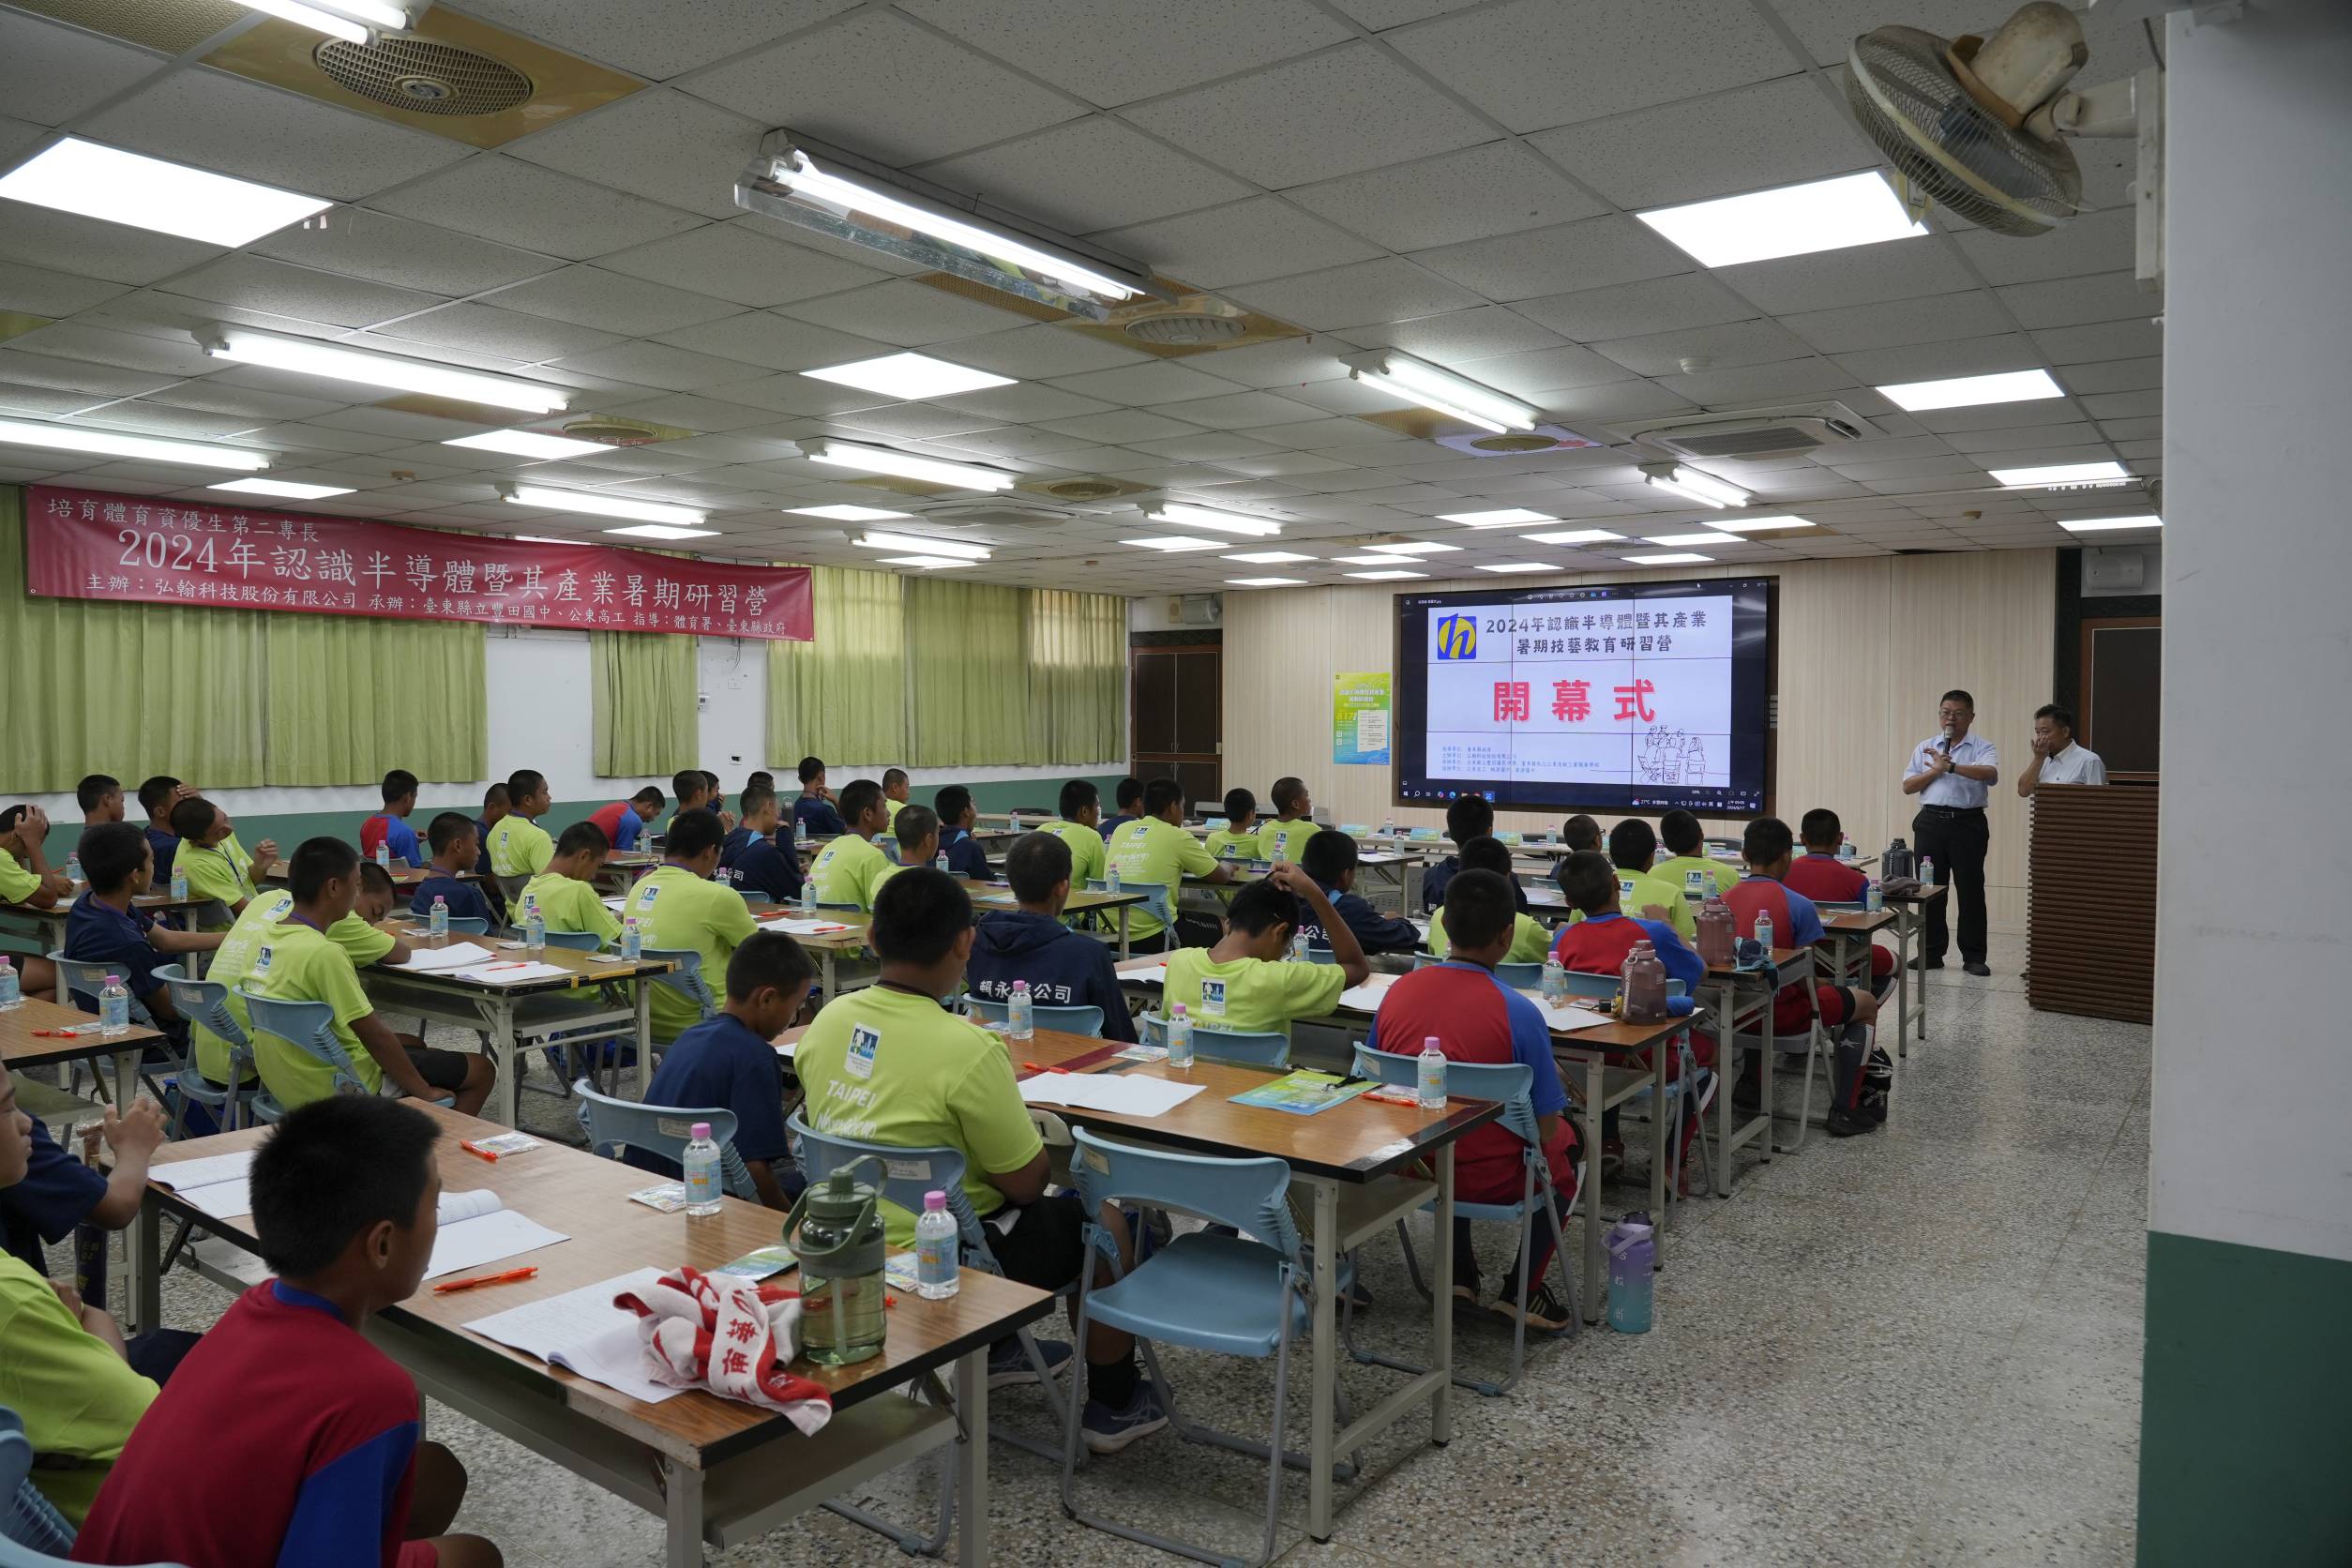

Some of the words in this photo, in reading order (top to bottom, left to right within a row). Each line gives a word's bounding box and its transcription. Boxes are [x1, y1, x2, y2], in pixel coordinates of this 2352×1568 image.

[118, 528, 768, 617] 2024年認識半導體暨其產業暑期研習營
[1485, 611, 1707, 634] 2024年認識半導體暨其產業
[1516, 634, 1673, 655] 暑期技藝教育研習營
[1492, 679, 1656, 723] 開幕式
[826, 1079, 877, 1110] TAIPEI
